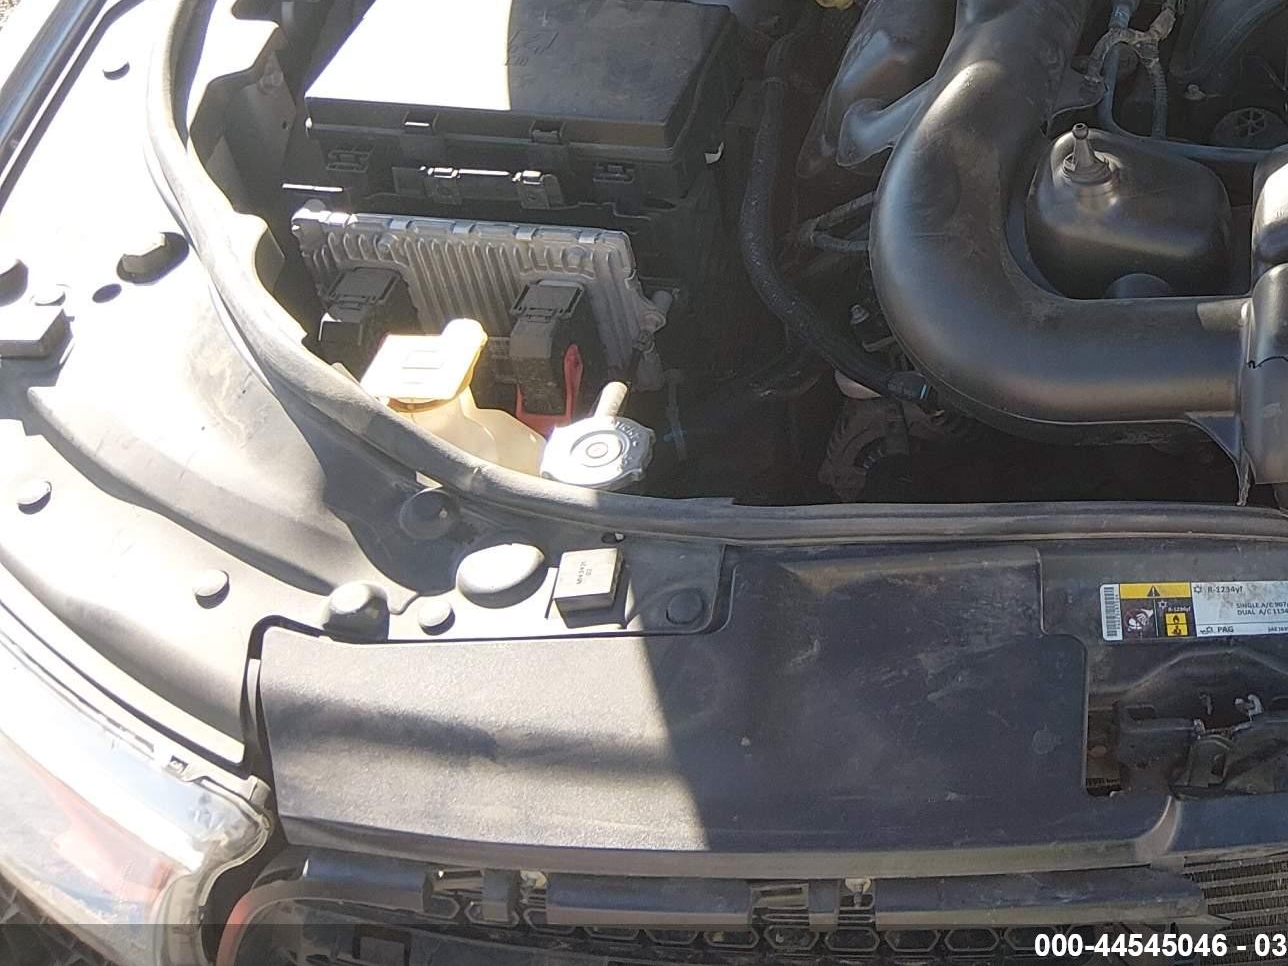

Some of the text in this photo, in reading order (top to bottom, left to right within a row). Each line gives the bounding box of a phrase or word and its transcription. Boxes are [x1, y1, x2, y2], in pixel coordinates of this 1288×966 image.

[1207, 586, 1243, 594] R-1234yf
[1261, 601, 1274, 609] A/C
[1259, 608, 1272, 616] A/C
